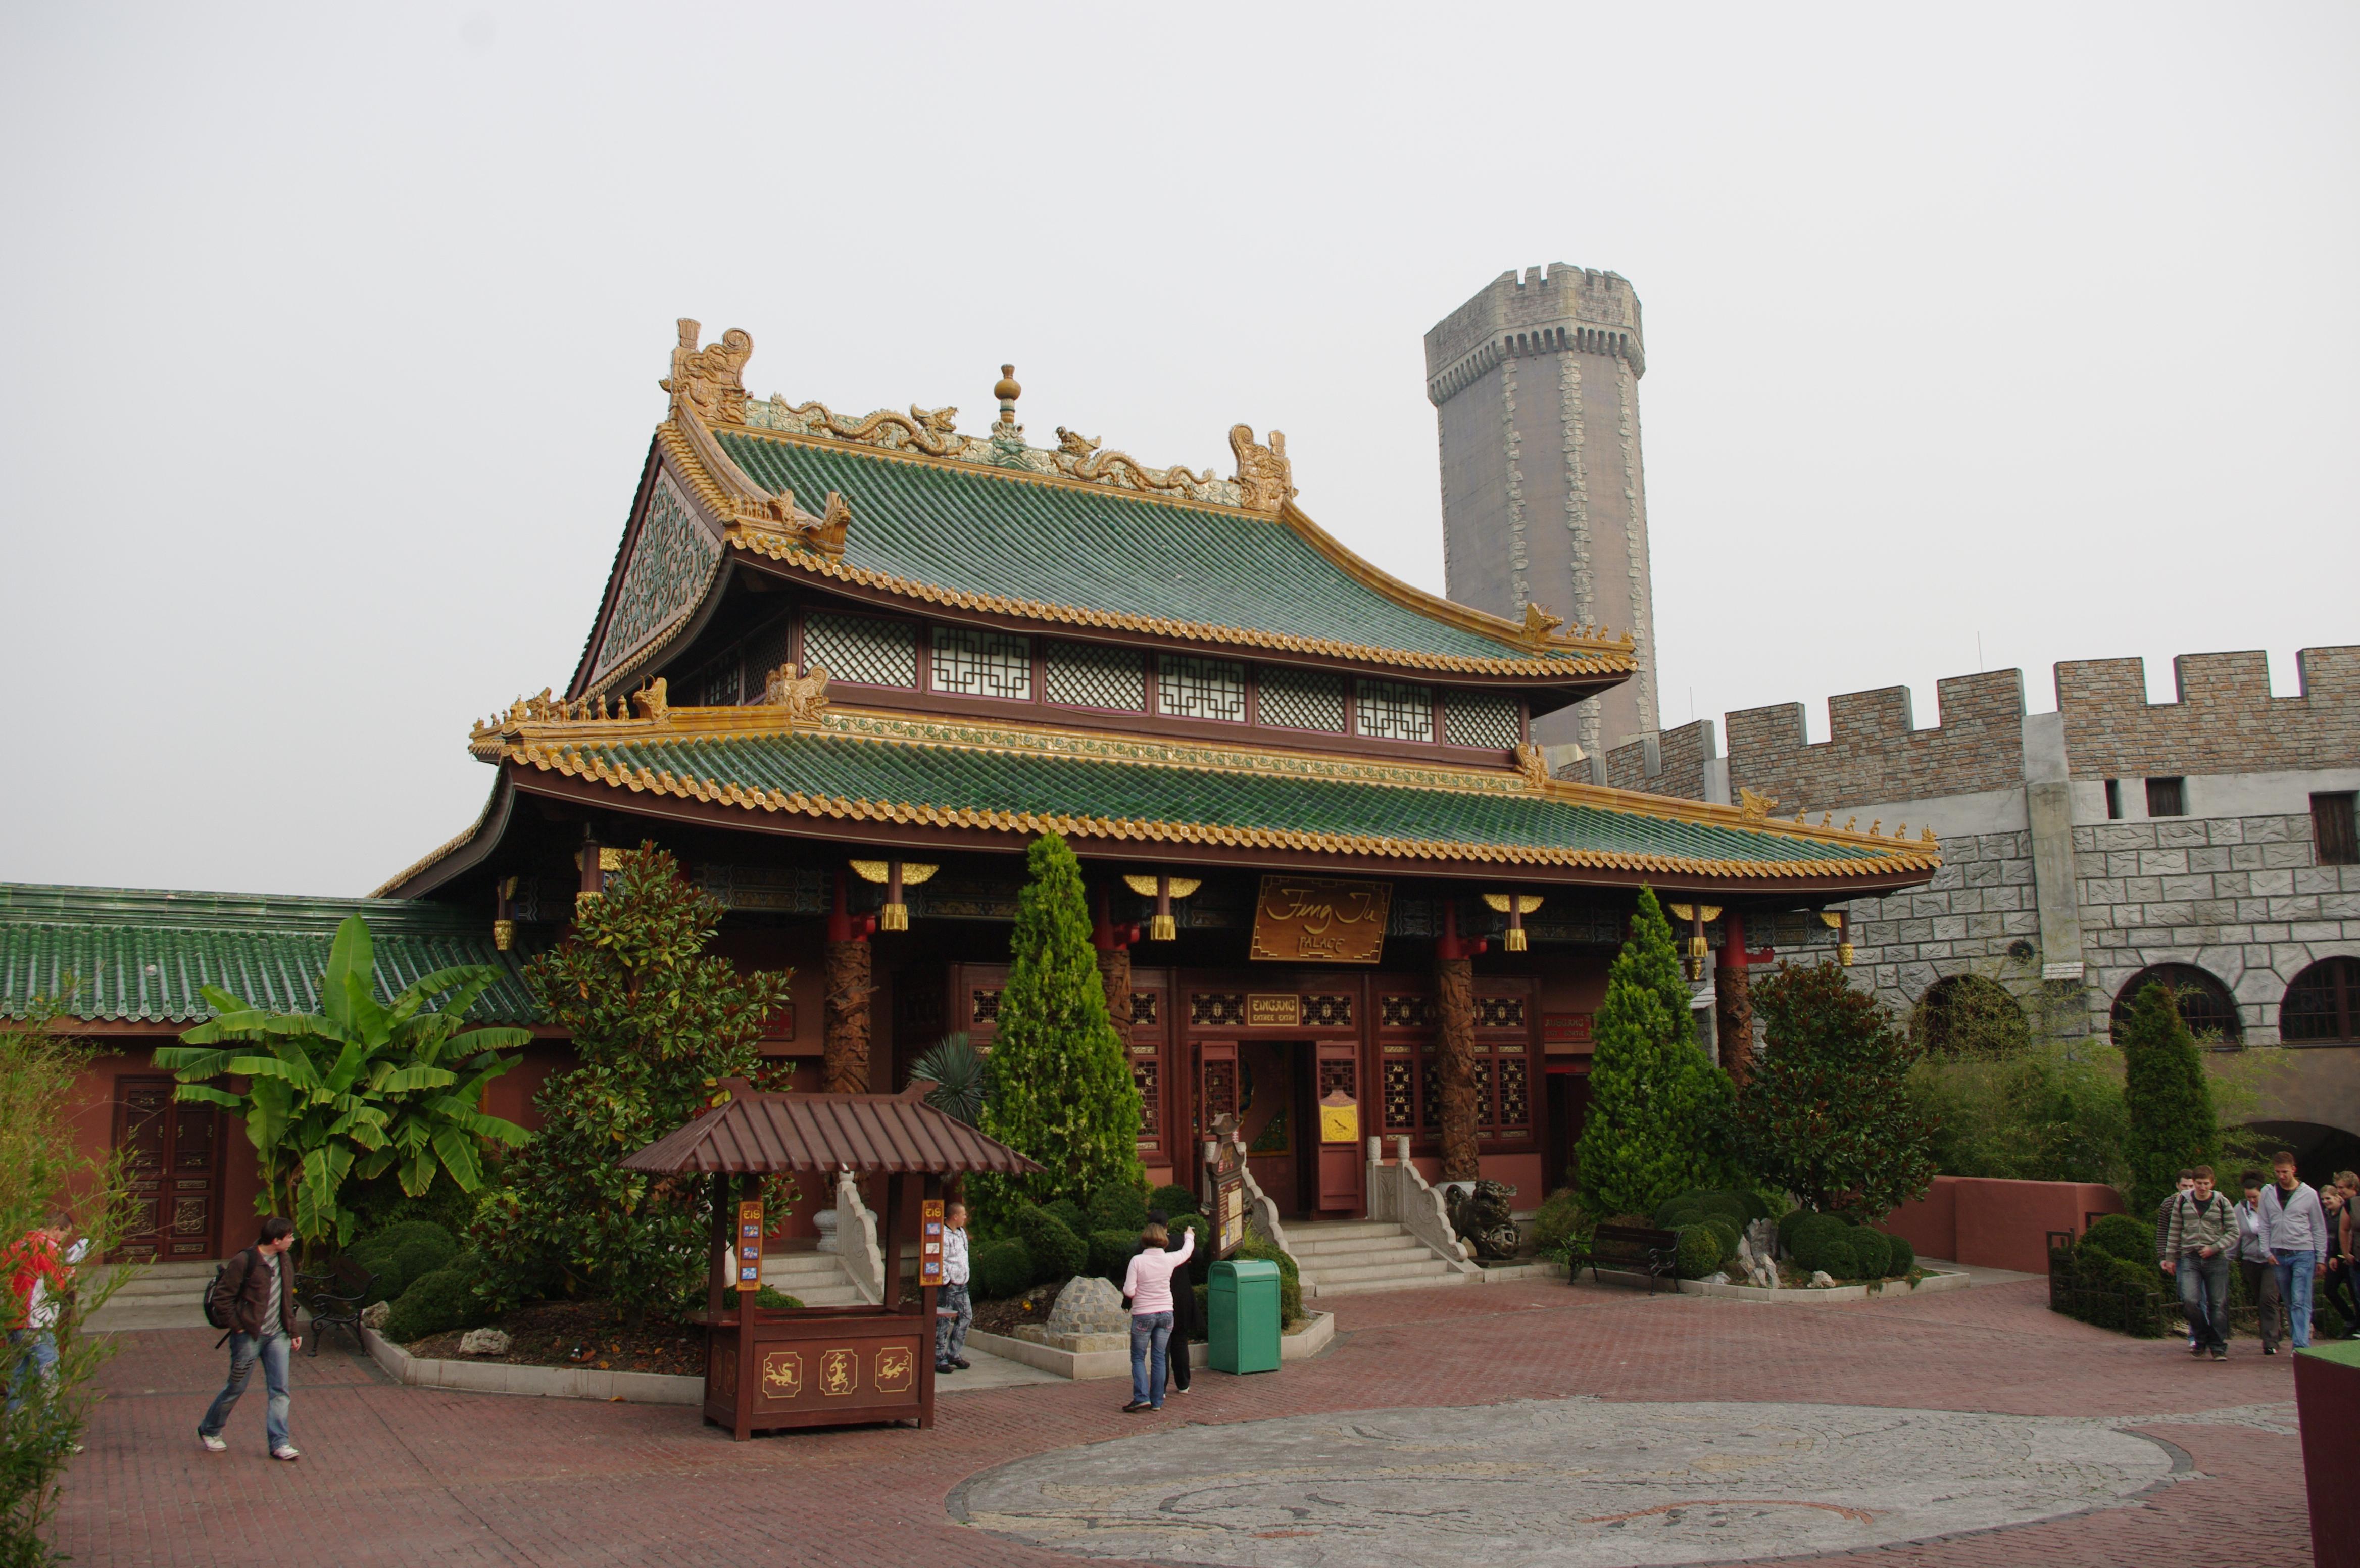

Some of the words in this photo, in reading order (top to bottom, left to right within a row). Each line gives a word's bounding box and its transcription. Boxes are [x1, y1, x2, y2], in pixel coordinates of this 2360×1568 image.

[1266, 889, 1332, 935] Feng
[1335, 892, 1378, 923] Ju
[1298, 936, 1345, 953] PALACE
[1252, 999, 1295, 1012] EINGANG
[1545, 1018, 1584, 1027] AUSGANG
[743, 1210, 761, 1219] EIS
[925, 1208, 942, 1217] EIS
